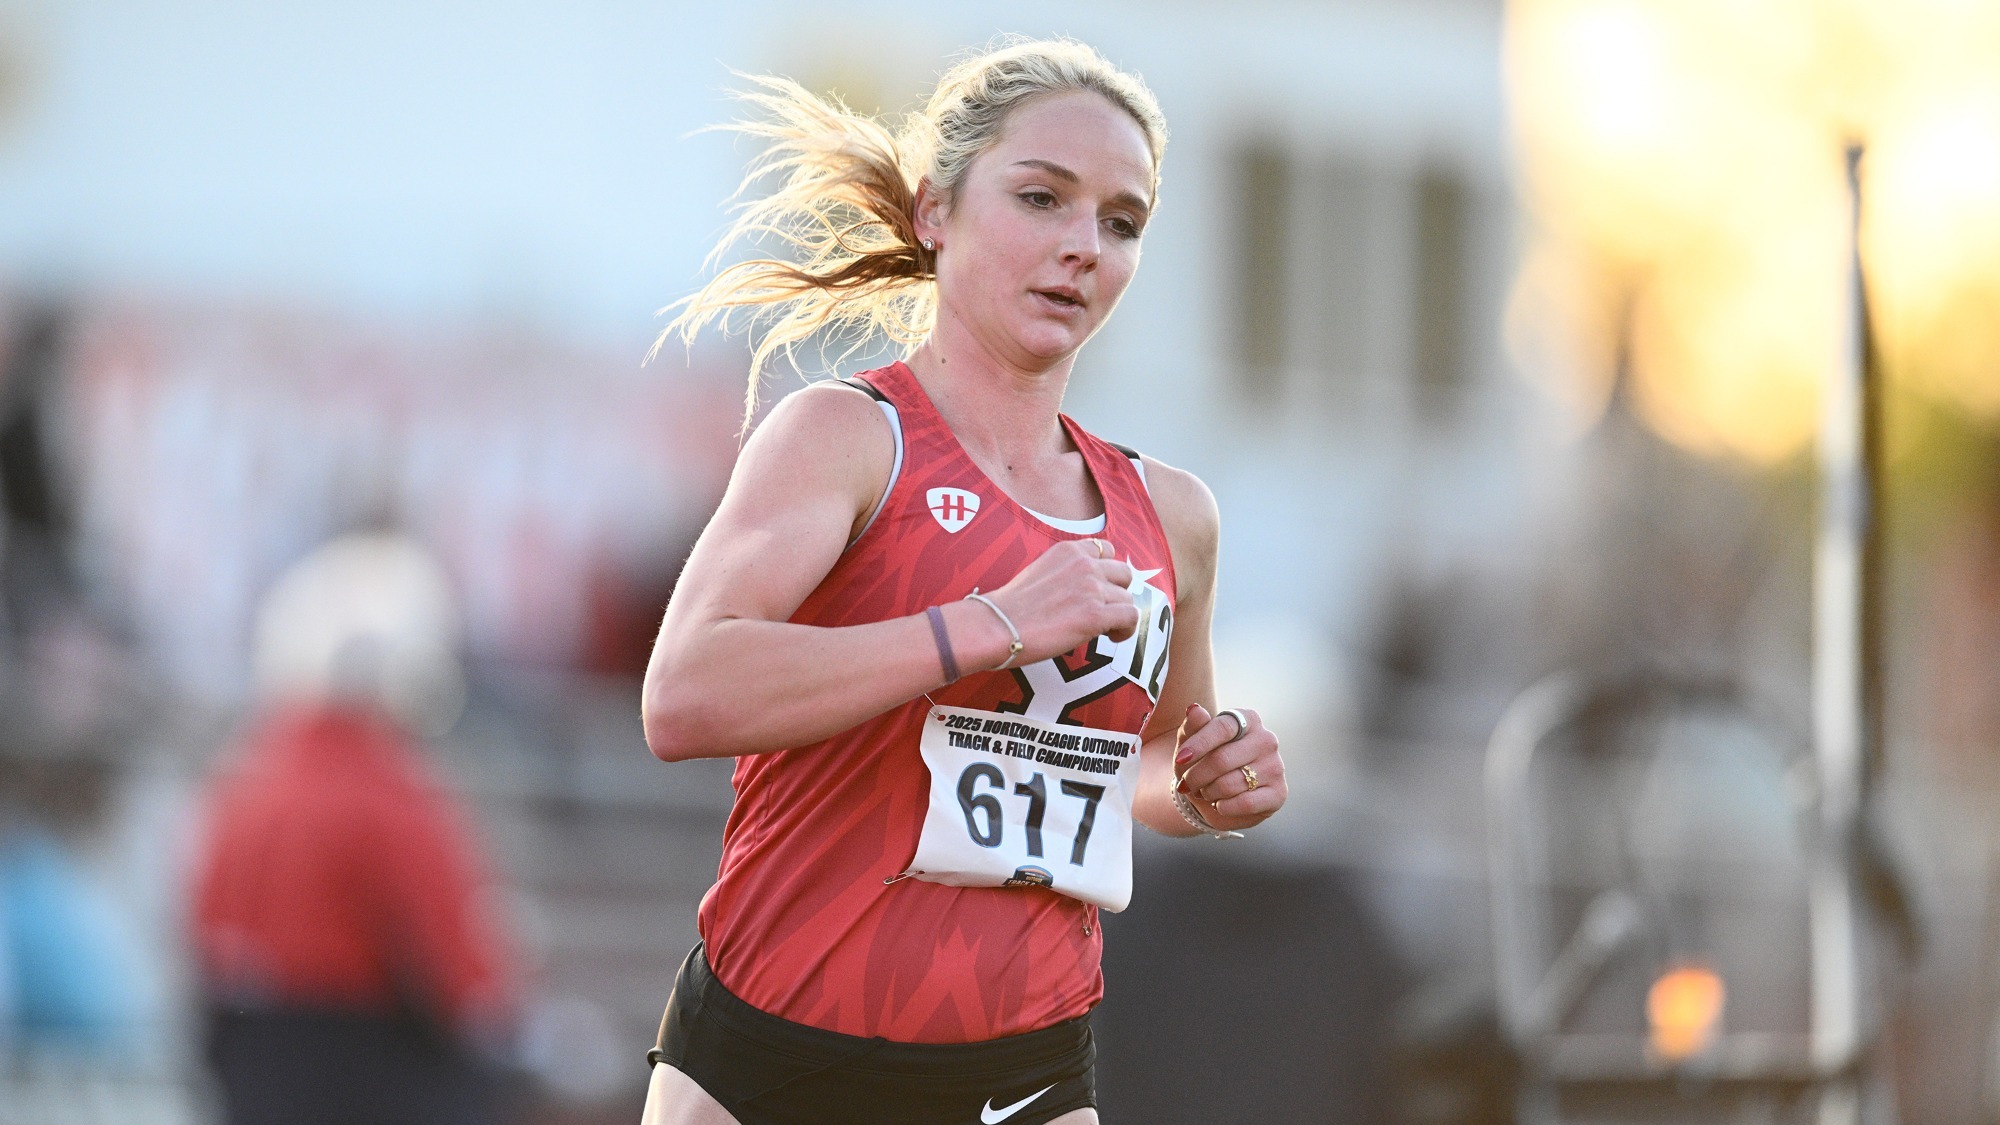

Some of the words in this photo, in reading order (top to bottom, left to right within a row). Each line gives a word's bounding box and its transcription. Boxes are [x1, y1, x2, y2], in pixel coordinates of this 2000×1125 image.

[945, 714, 983, 731] 2025
[982, 719, 1040, 741] HORIZON
[1038, 730, 1081, 751] LEAGUE
[1082, 736, 1130, 758] OUTDOOR
[948, 730, 992, 752] TRACK
[992, 740, 1003, 754] &
[1005, 740, 1037, 760] FIELD
[1036, 748, 1120, 775] CHAMPIONSHIP
[956, 761, 1106, 867] 617
